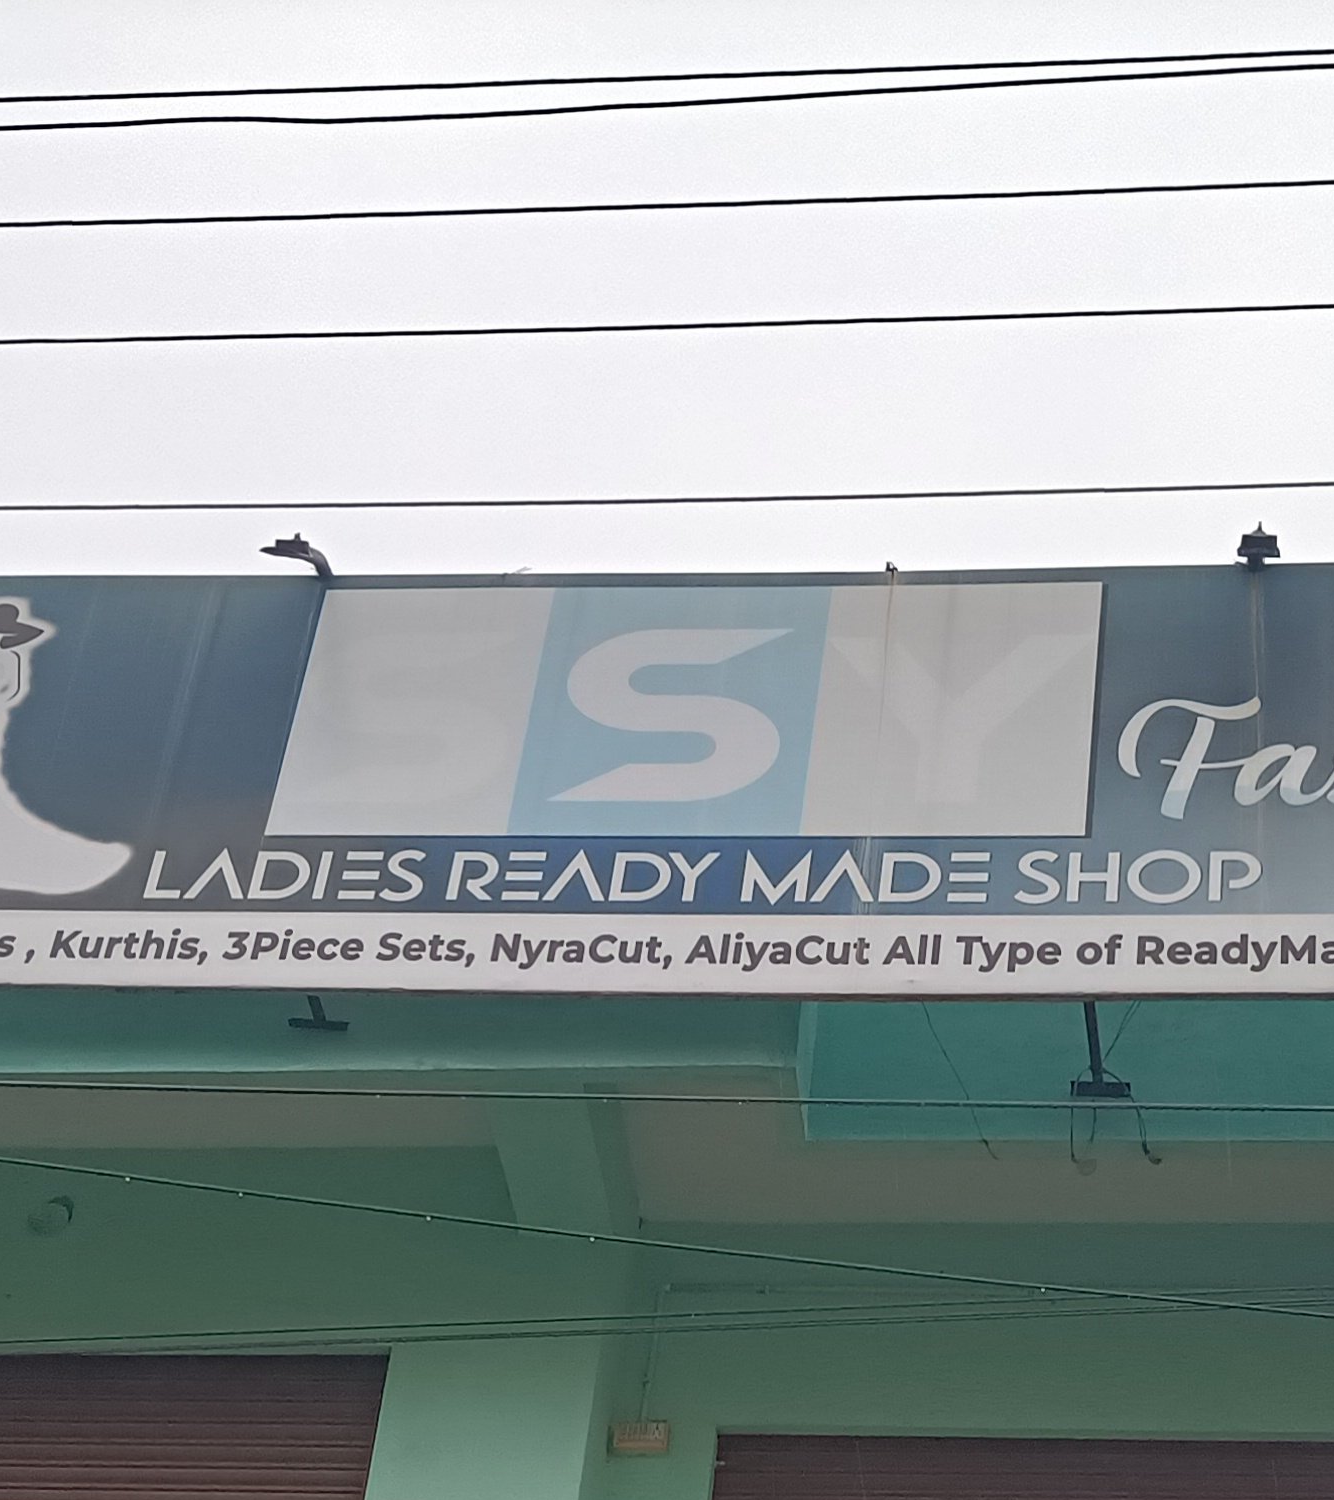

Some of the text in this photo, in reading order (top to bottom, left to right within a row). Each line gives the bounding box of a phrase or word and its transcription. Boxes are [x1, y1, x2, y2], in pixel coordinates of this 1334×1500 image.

[143, 847, 1264, 905] LADIES READY MADE SHOP
[49, 927, 209, 967] Kurthis,
[221, 930, 364, 964] 3Piece
[376, 931, 476, 969] Sets,
[490, 934, 674, 972] NyraCut,
[685, 933, 871, 971] AliyaCut
[883, 933, 942, 966] All
[955, 935, 1062, 972] Type
[1078, 933, 1123, 966] of
